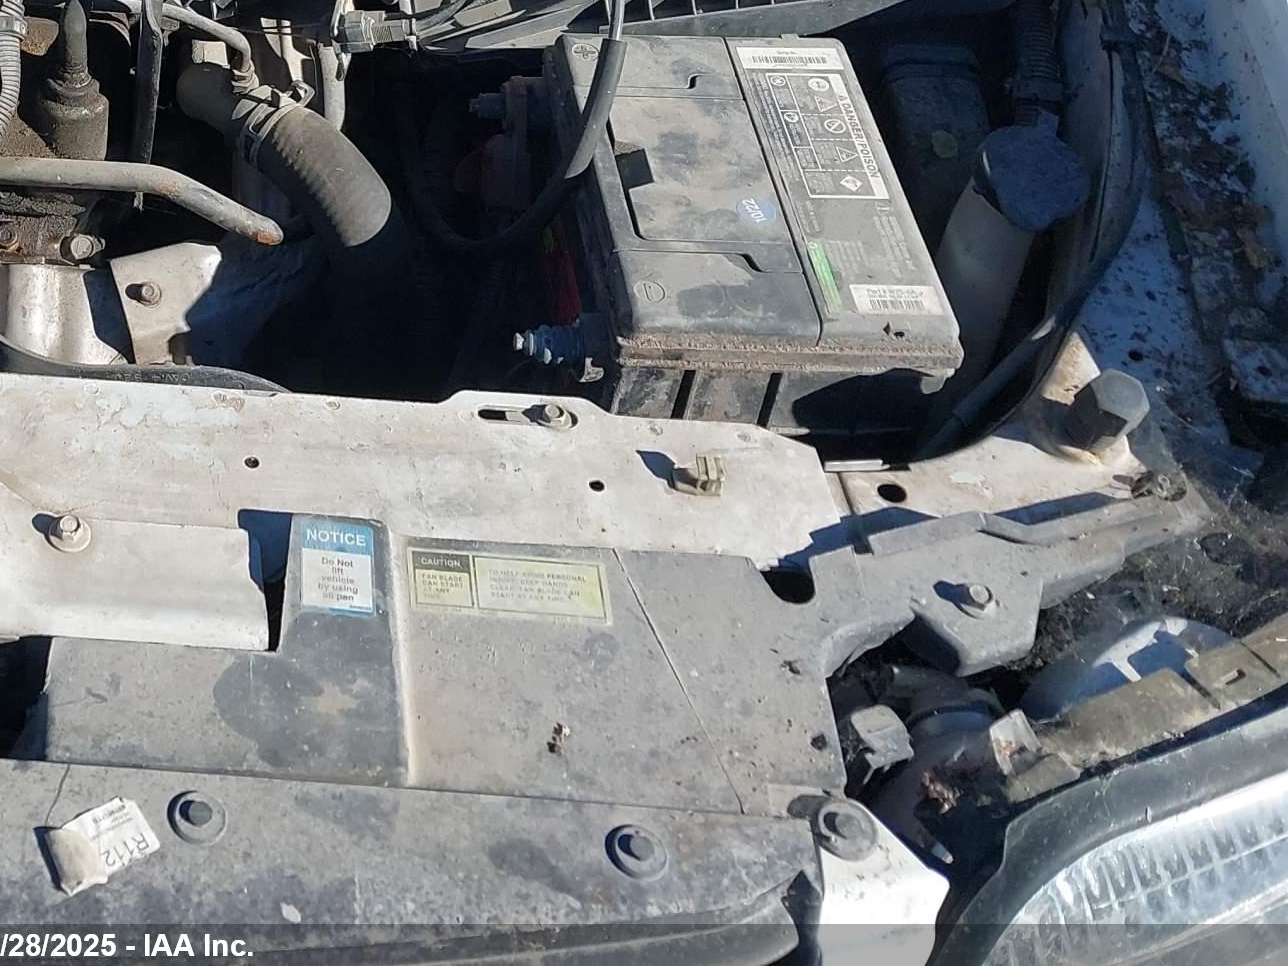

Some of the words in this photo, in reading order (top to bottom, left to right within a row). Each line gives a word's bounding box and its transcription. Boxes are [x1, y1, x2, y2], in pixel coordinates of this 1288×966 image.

[841, 103, 880, 178] DANGER/POISON
[742, 197, 767, 223] 10/22
[306, 528, 366, 547] NOTICE
[321, 556, 335, 566] Do
[336, 557, 353, 568] Not
[421, 557, 461, 567] CAUTION
[332, 566, 344, 576] lift
[321, 575, 355, 585] vehicle
[547, 574, 586, 583] PERSONAL
[318, 583, 330, 593] by
[332, 584, 359, 595] using
[336, 592, 354, 602] pan
